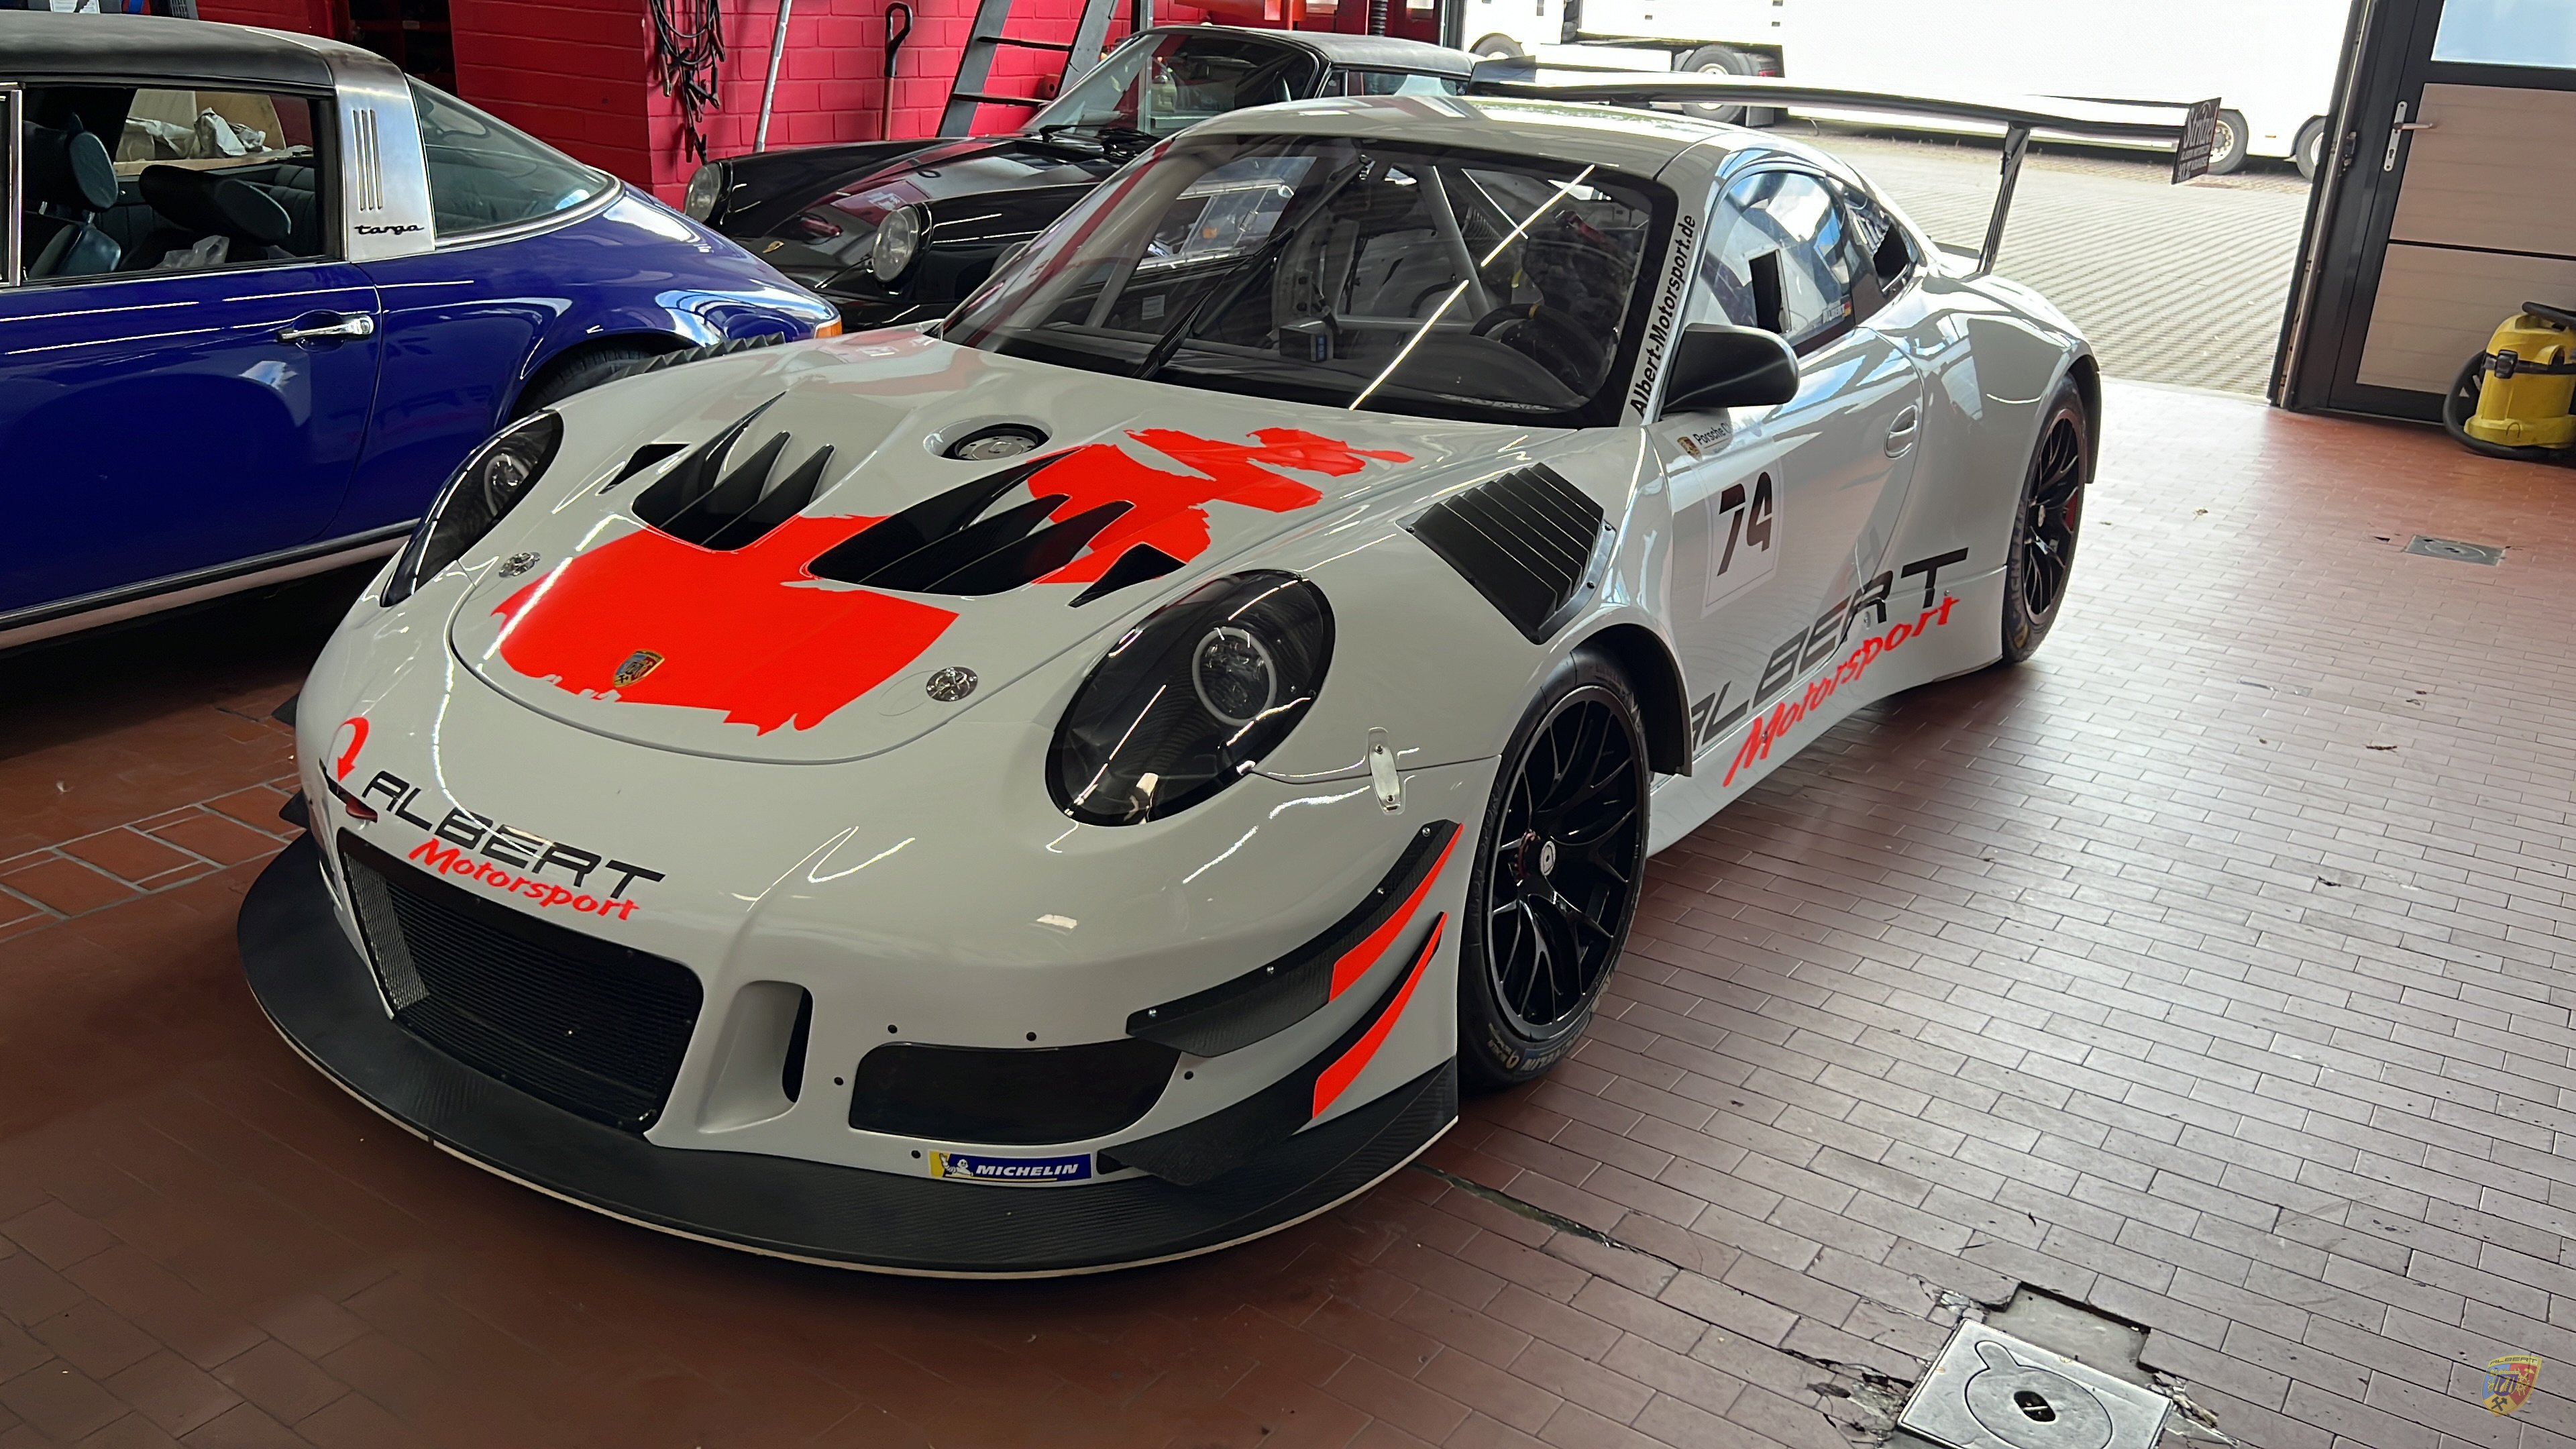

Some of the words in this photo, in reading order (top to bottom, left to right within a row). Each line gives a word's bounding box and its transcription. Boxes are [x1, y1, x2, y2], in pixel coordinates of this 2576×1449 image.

[354, 225, 425, 235] targa
[1629, 214, 1697, 420] Albert-Motorsport.de
[1692, 427, 1726, 445] Porsche
[1717, 471, 1772, 577] 74
[1690, 547, 1969, 752] ALBERT
[1722, 596, 1962, 788] Motorsport
[361, 769, 667, 900] ALBERT
[408, 837, 641, 921] Motorsport
[975, 1163, 1079, 1177] MICHELIN
